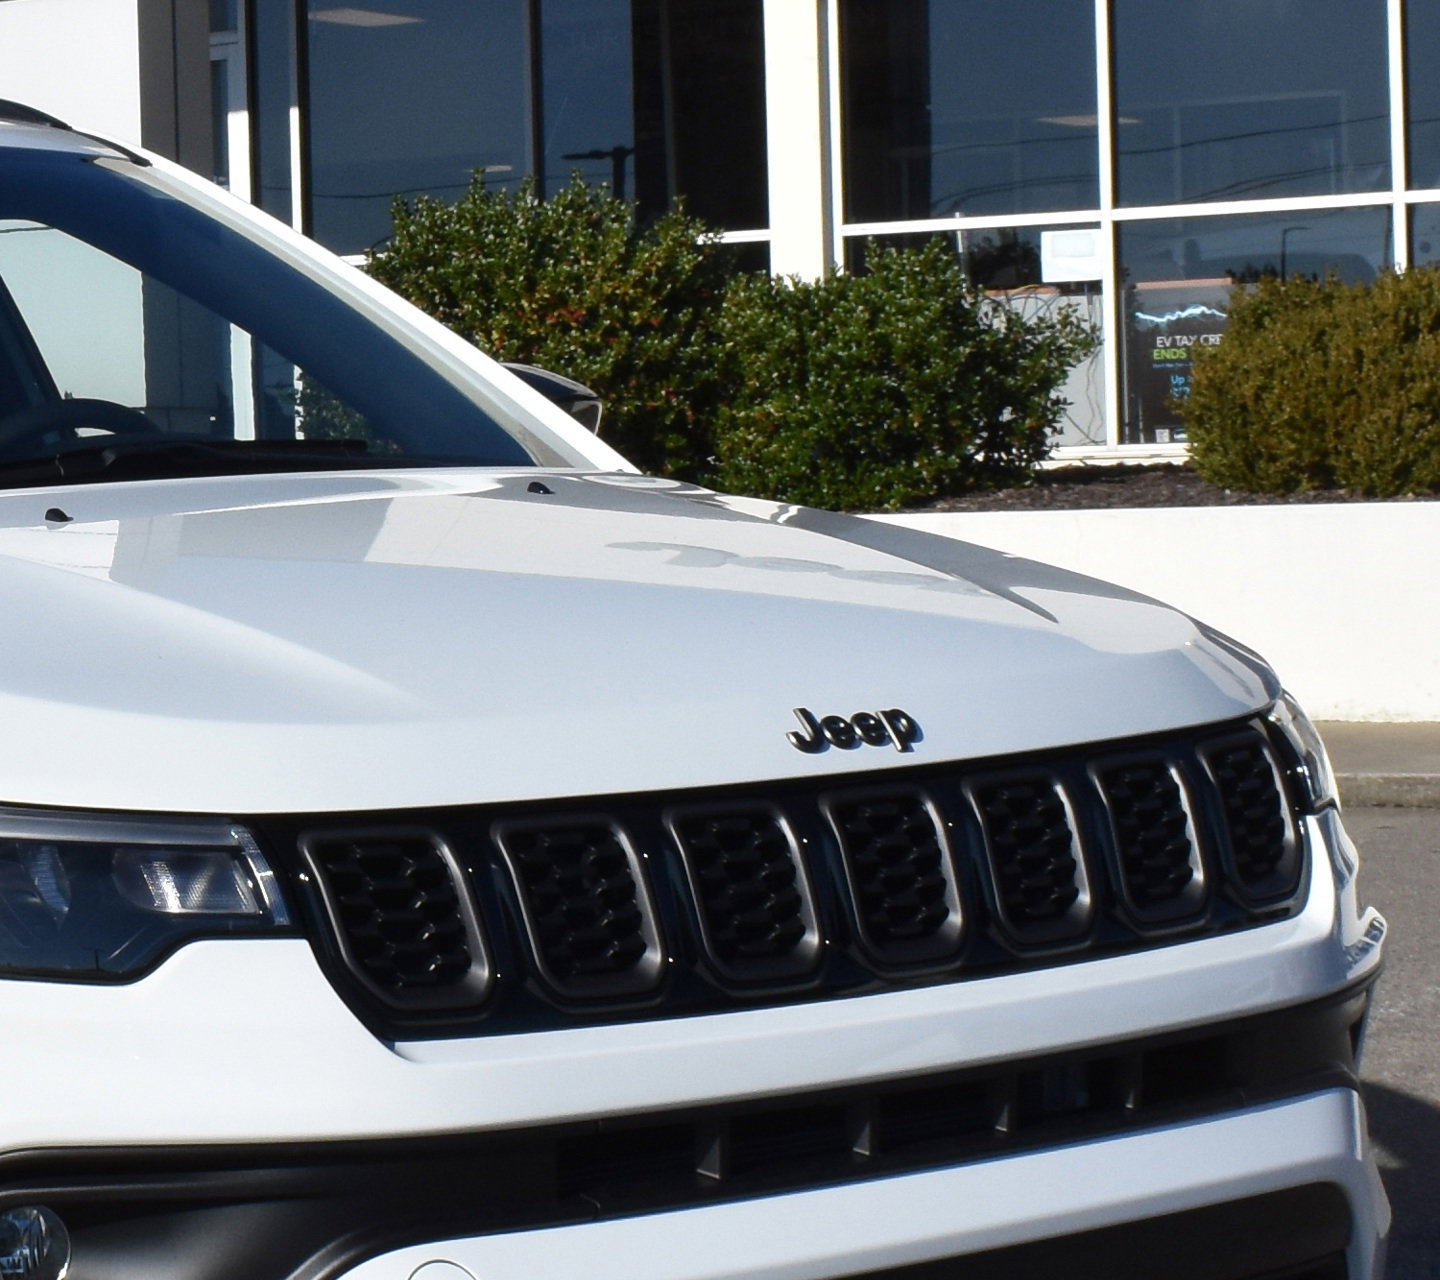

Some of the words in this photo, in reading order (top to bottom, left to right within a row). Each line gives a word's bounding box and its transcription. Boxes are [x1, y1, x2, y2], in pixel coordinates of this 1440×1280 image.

[1156, 335, 1172, 347] EV
[1200, 333, 1224, 345] CRE
[1153, 347, 1187, 360] ENDS
[1171, 375, 1185, 385] Up
[786, 708, 921, 753] Jeep
